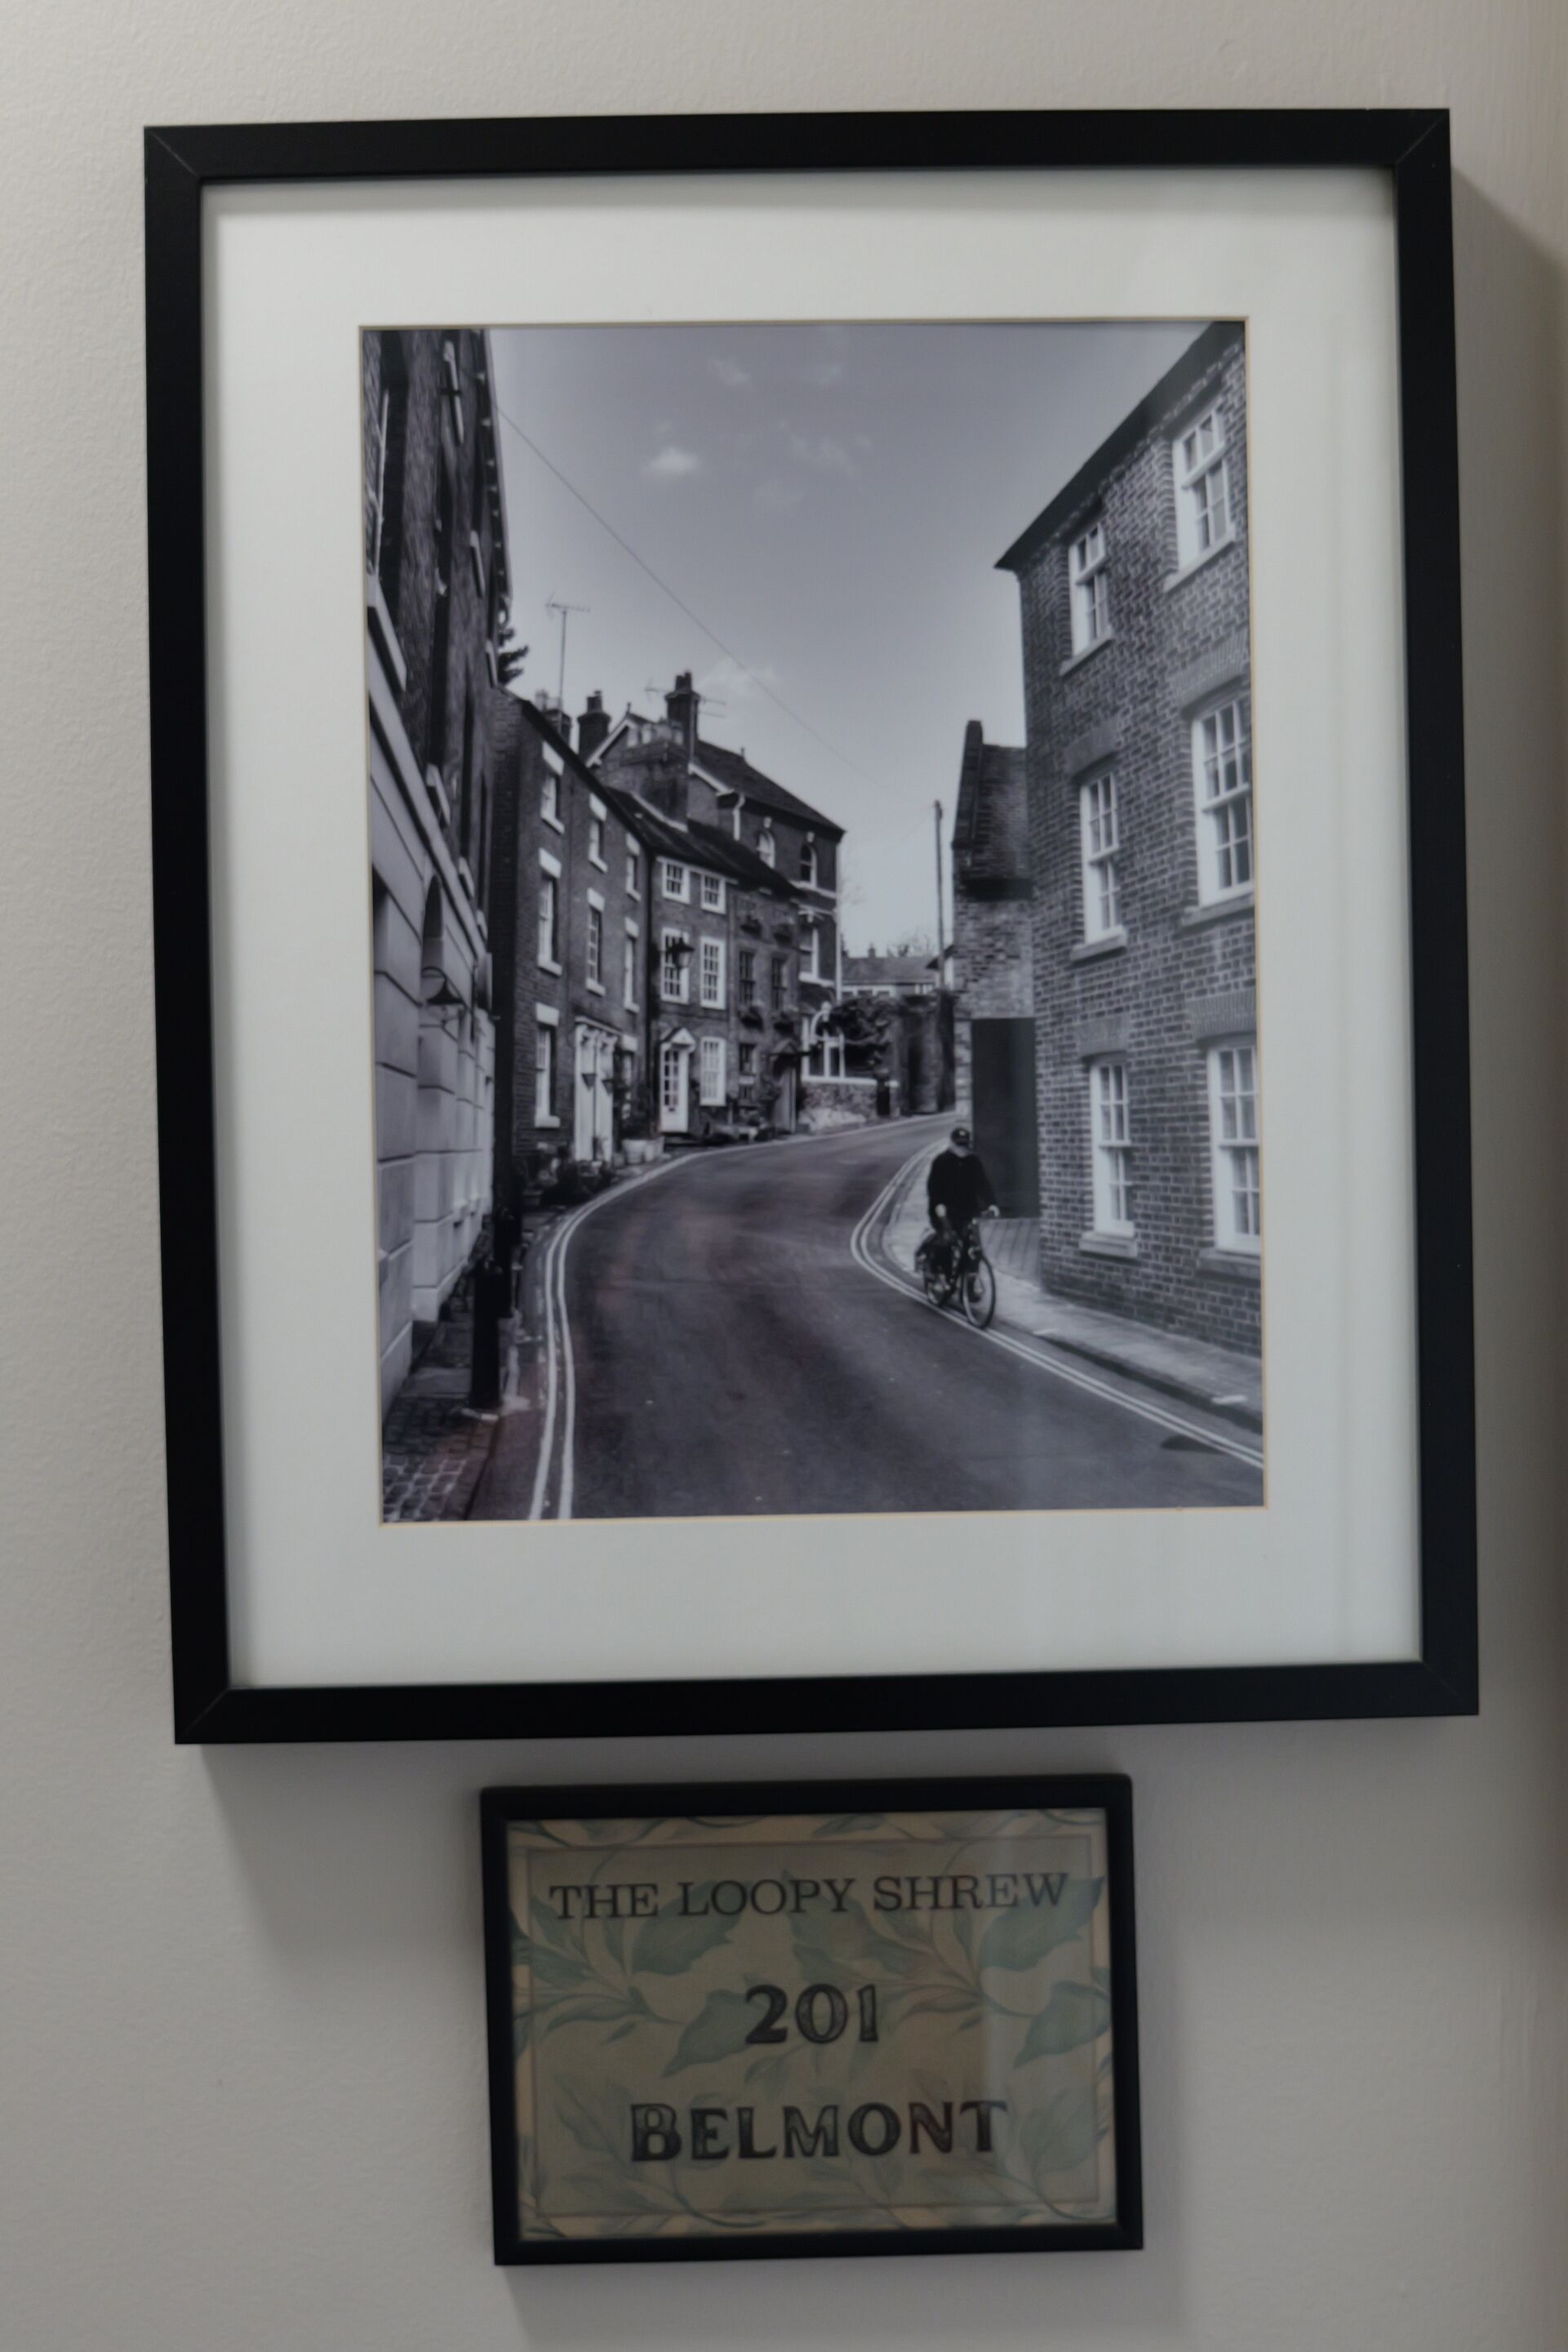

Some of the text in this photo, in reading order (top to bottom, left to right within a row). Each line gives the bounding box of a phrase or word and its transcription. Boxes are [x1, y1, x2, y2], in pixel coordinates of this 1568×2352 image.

[549, 1872, 1069, 1920] THE LOOPY SHREW
[744, 1984, 879, 2044] 201
[630, 2100, 1008, 2162] BELMONT
